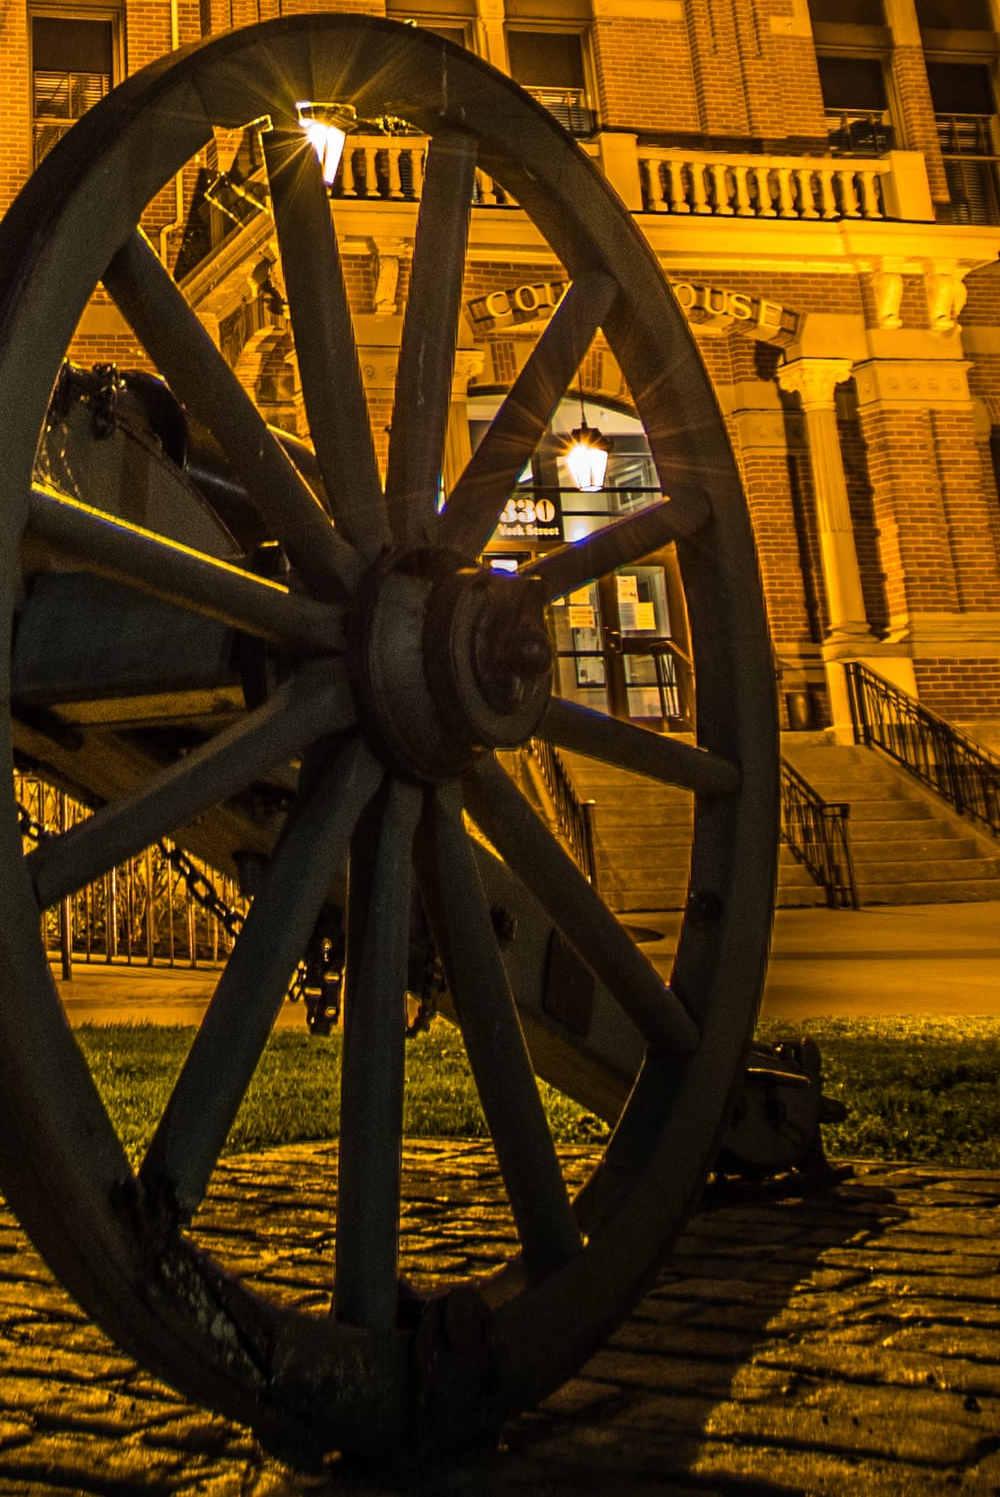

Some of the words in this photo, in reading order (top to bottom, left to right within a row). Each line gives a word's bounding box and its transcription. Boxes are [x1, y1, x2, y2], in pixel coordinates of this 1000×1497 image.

[486, 281, 569, 317] COU
[672, 283, 784, 330] OUSE
[500, 499, 555, 523] 330
[525, 523, 560, 536] Street
